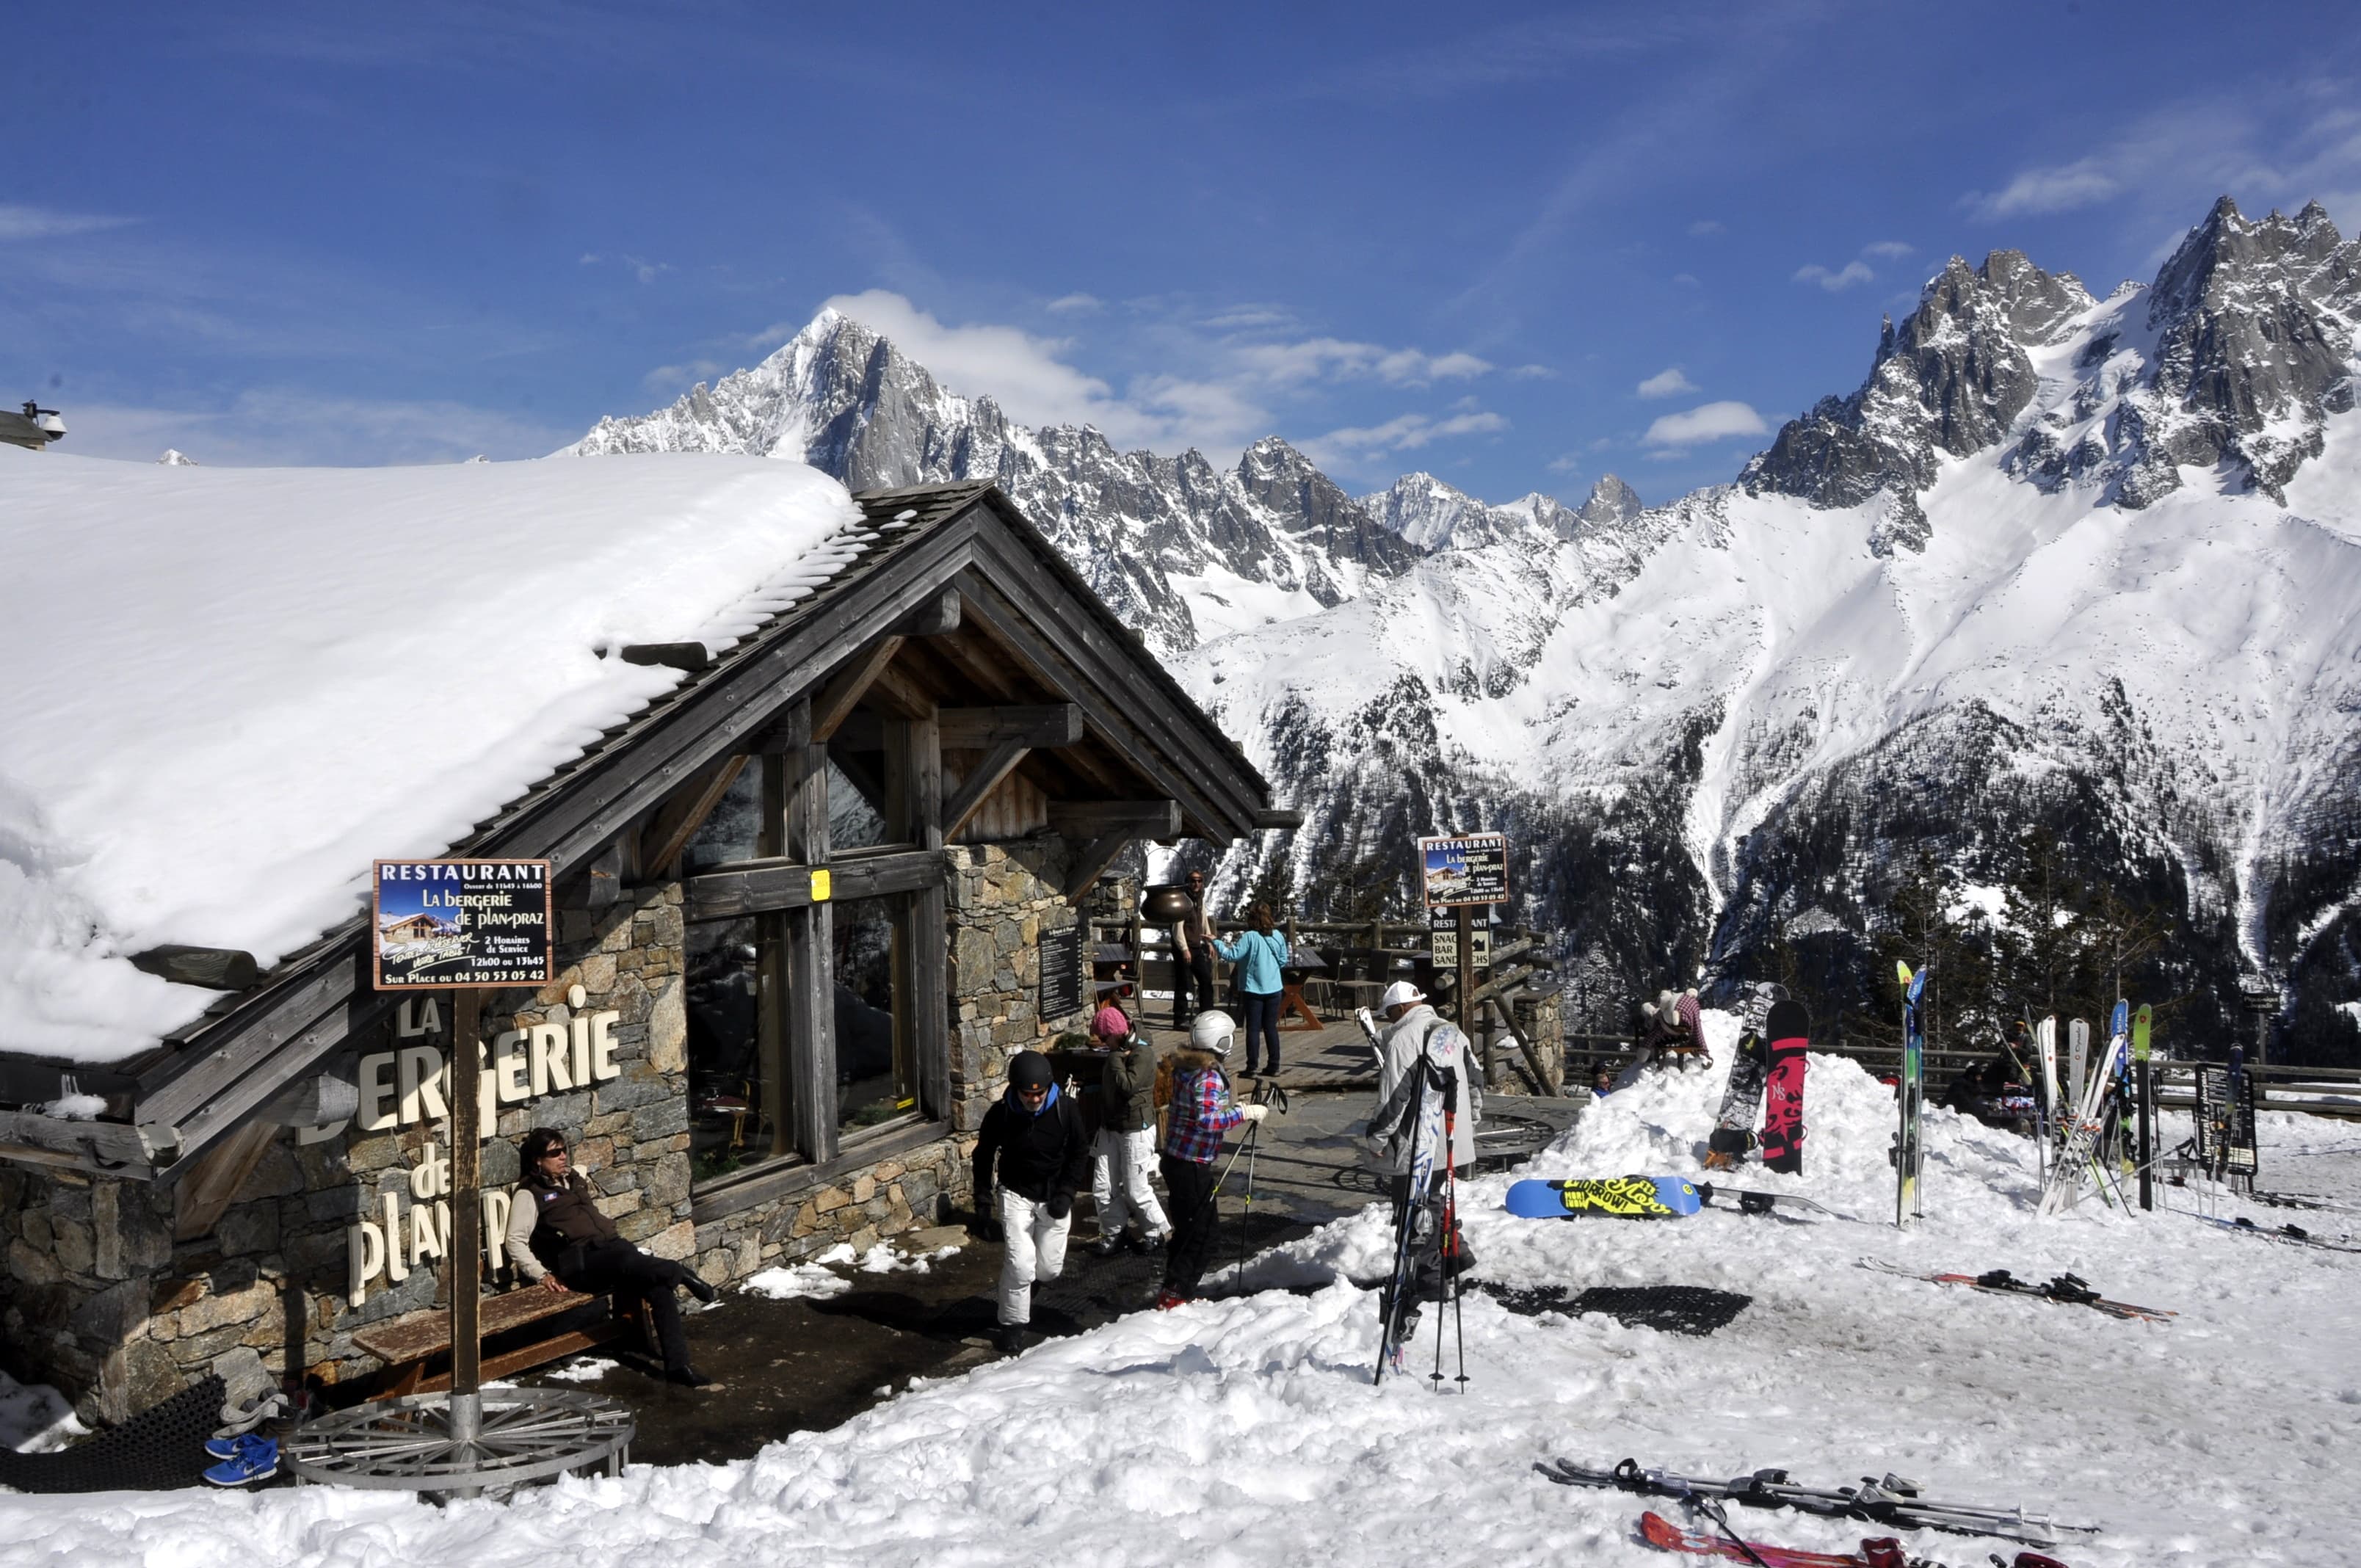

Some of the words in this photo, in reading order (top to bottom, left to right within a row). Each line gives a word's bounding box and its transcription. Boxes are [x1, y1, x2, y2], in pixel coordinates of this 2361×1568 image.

[1426, 838, 1502, 852] RESTAURANT
[382, 865, 544, 880] RESTAURANT
[1433, 918, 1488, 928] RESTANT
[485, 936, 491, 945] 2
[1435, 934, 1457, 944] SNAC
[1435, 945, 1453, 954] BAR
[471, 957, 500, 967] 12h00
[515, 956, 545, 965] 13h45
[454, 973, 470, 982] 04
[474, 971, 490, 981] 50
[493, 971, 507, 981] 53
[511, 970, 526, 981] 05
[529, 970, 545, 980] 42
[397, 996, 442, 1038] LA
